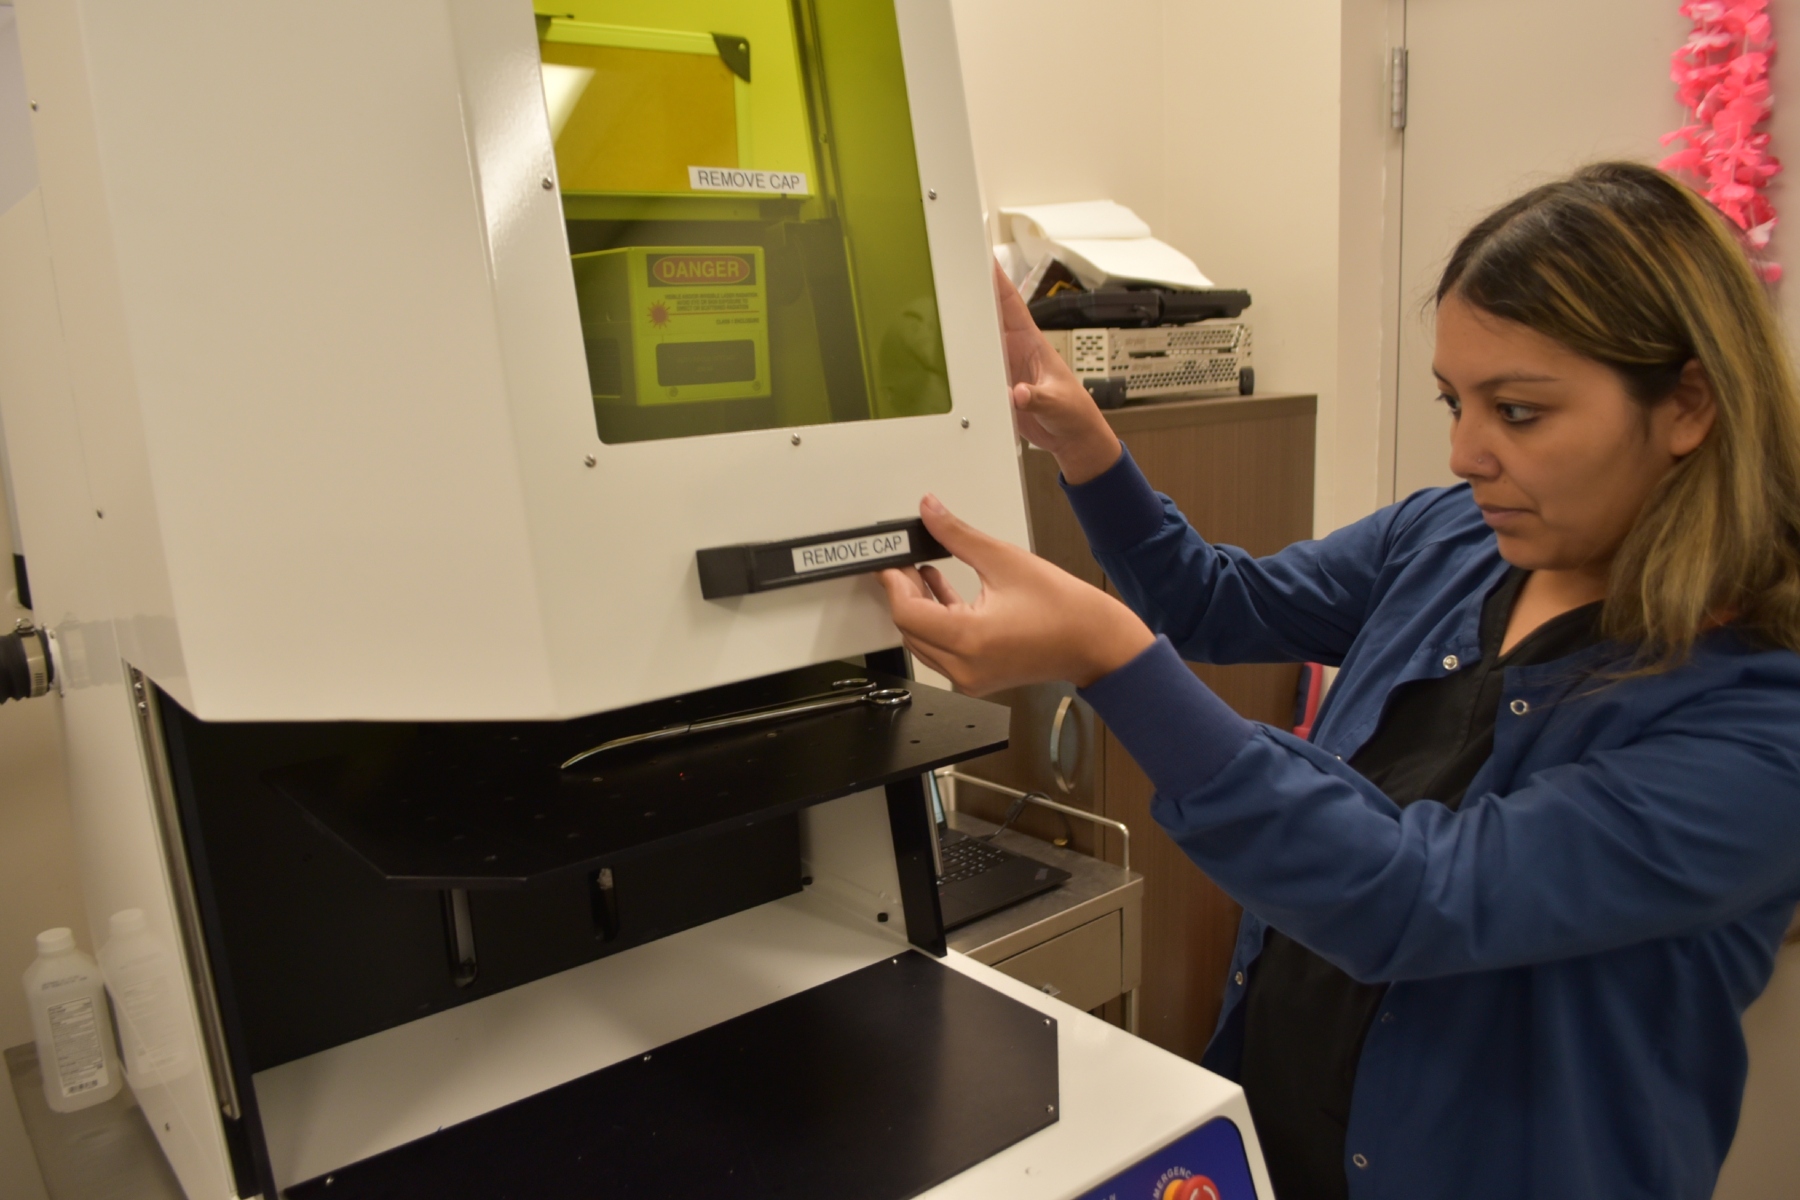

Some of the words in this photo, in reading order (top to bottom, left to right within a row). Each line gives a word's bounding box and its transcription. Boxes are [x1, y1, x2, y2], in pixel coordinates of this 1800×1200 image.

[698, 169, 766, 189] REMOVE
[769, 173, 799, 190] CAP
[663, 260, 740, 279] DANGER
[802, 541, 869, 567] REMOVE
[872, 535, 902, 554] CAP
[1152, 1166, 1196, 1200] MERGENC
